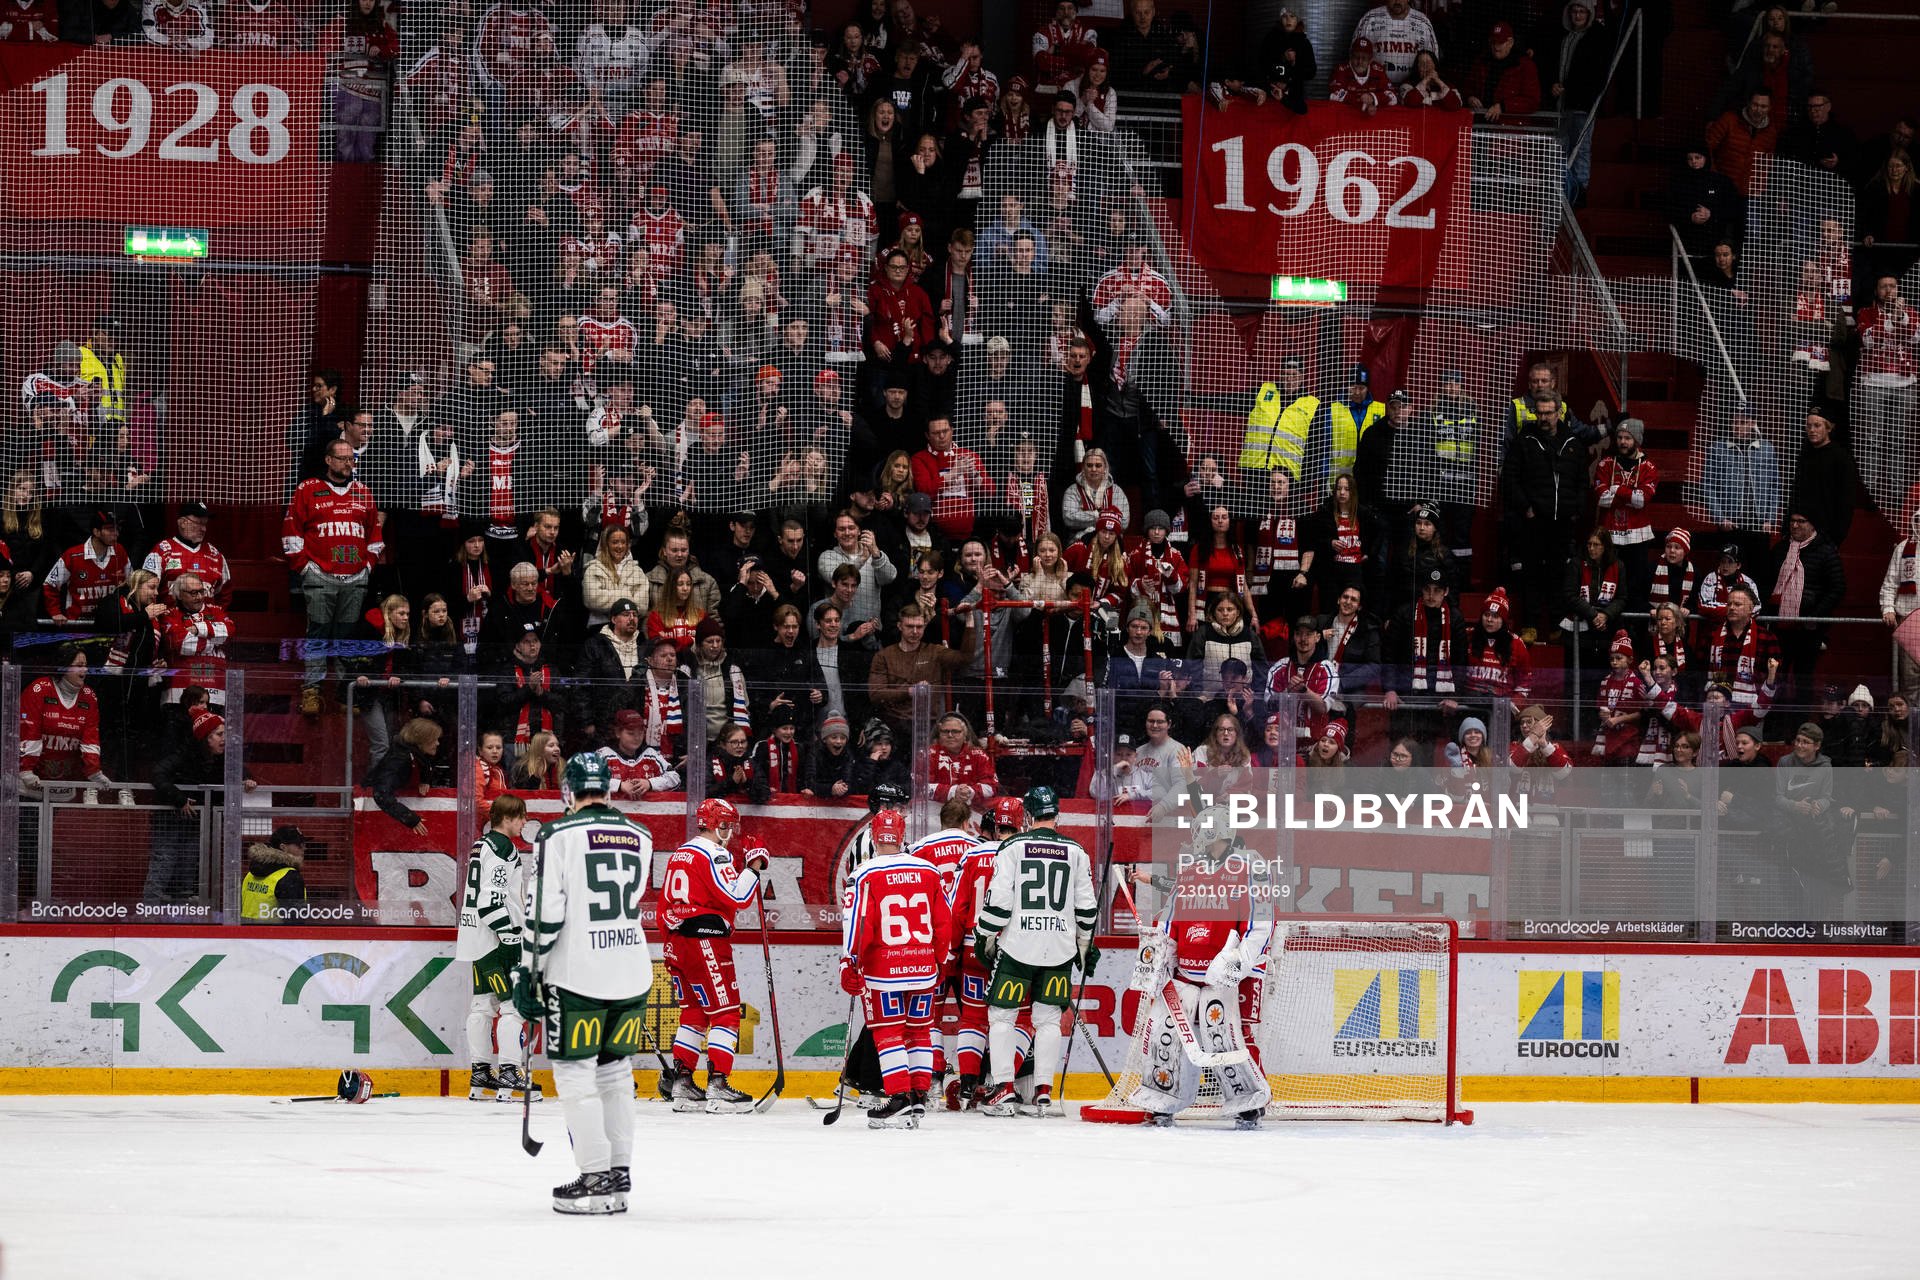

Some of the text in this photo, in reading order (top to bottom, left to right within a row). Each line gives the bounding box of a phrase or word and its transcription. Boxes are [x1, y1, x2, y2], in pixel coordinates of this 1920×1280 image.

[32, 73, 291, 165] 1928
[1212, 135, 1437, 230] 1962
[586, 762, 600, 772] 52
[1041, 794, 1051, 802] 20
[1001, 815, 1010, 825] 10
[592, 833, 639, 847] LÖFBERGS
[884, 834, 894, 843] 63
[1028, 846, 1065, 857] LÖFBERGS
[719, 866, 737, 884] 19
[886, 872, 922, 885] ERONEN
[585, 852, 642, 922] 52
[1020, 859, 1071, 912] 20
[973, 875, 988, 925] 1
[31, 901, 211, 919] Brandcode Sportpriser
[259, 902, 354, 920] Brandcode
[879, 892, 933, 946] 63
[1524, 919, 1684, 935] Brandcode Arbetskläder
[1732, 922, 1888, 938] Brandcode Ljusskyltar
[890, 965, 932, 975] BILBOLAGET
[50, 949, 227, 1053] GK
[282, 952, 457, 1055] GK
[548, 985, 561, 1051] KLARA
[1166, 988, 1195, 1044] BAUER
[1333, 1040, 1438, 1057] EUROCON
[1517, 1041, 1620, 1058] EUROCON
